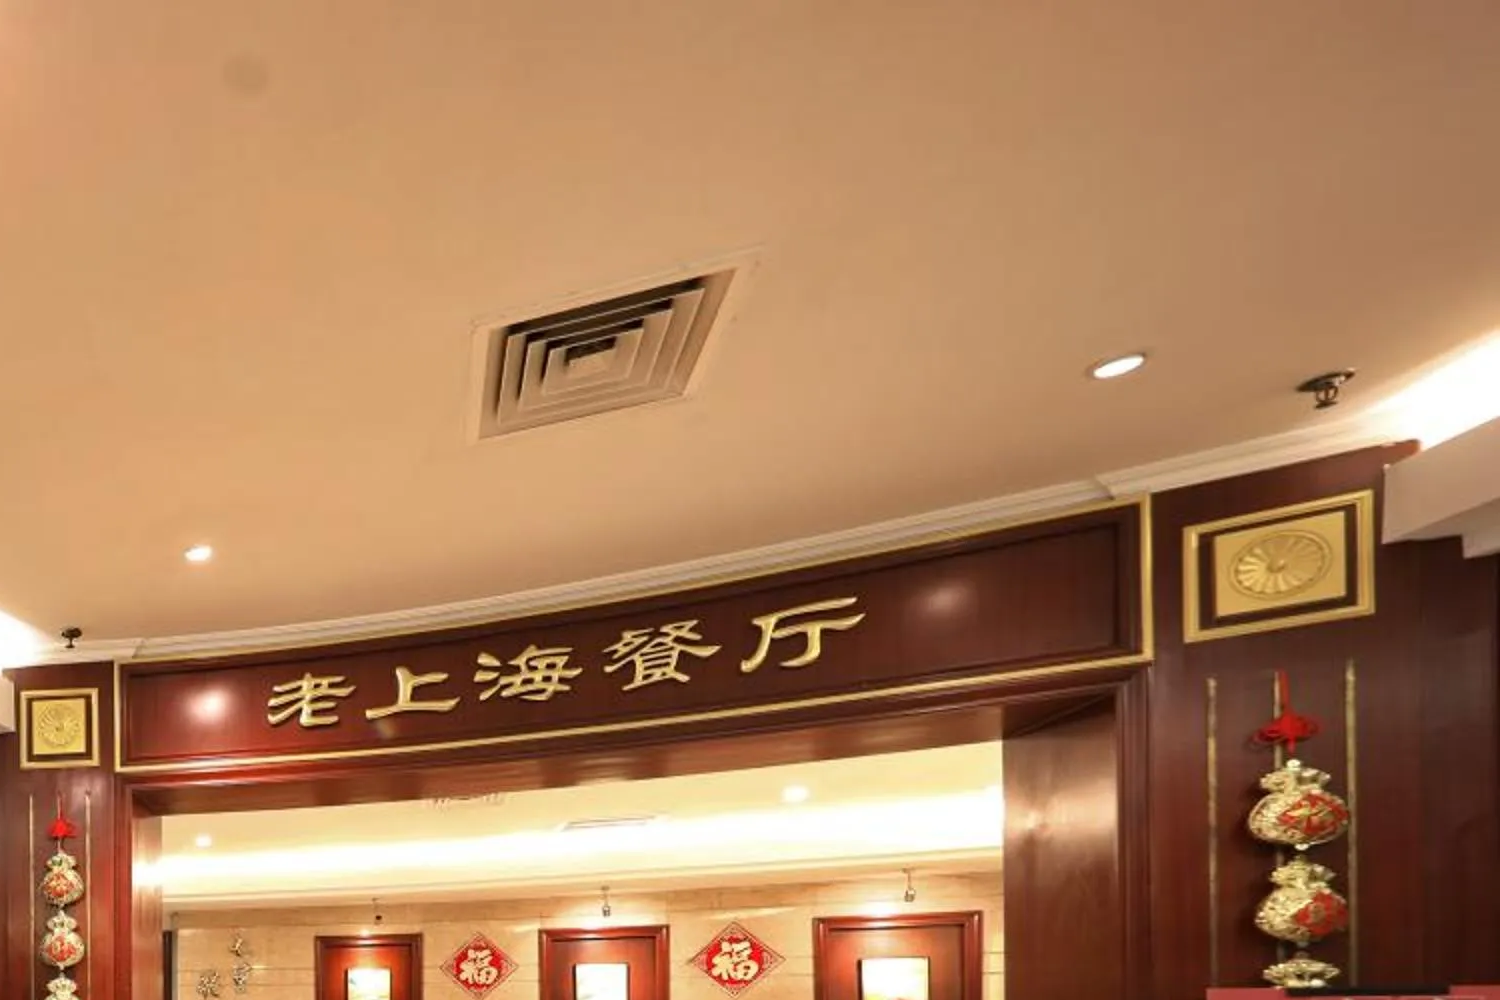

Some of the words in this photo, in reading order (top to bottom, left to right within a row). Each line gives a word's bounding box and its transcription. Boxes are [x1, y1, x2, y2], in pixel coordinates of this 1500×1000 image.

[266, 596, 866, 728] 老上海餐厅
[459, 948, 498, 986] 福
[710, 940, 759, 982] 福
